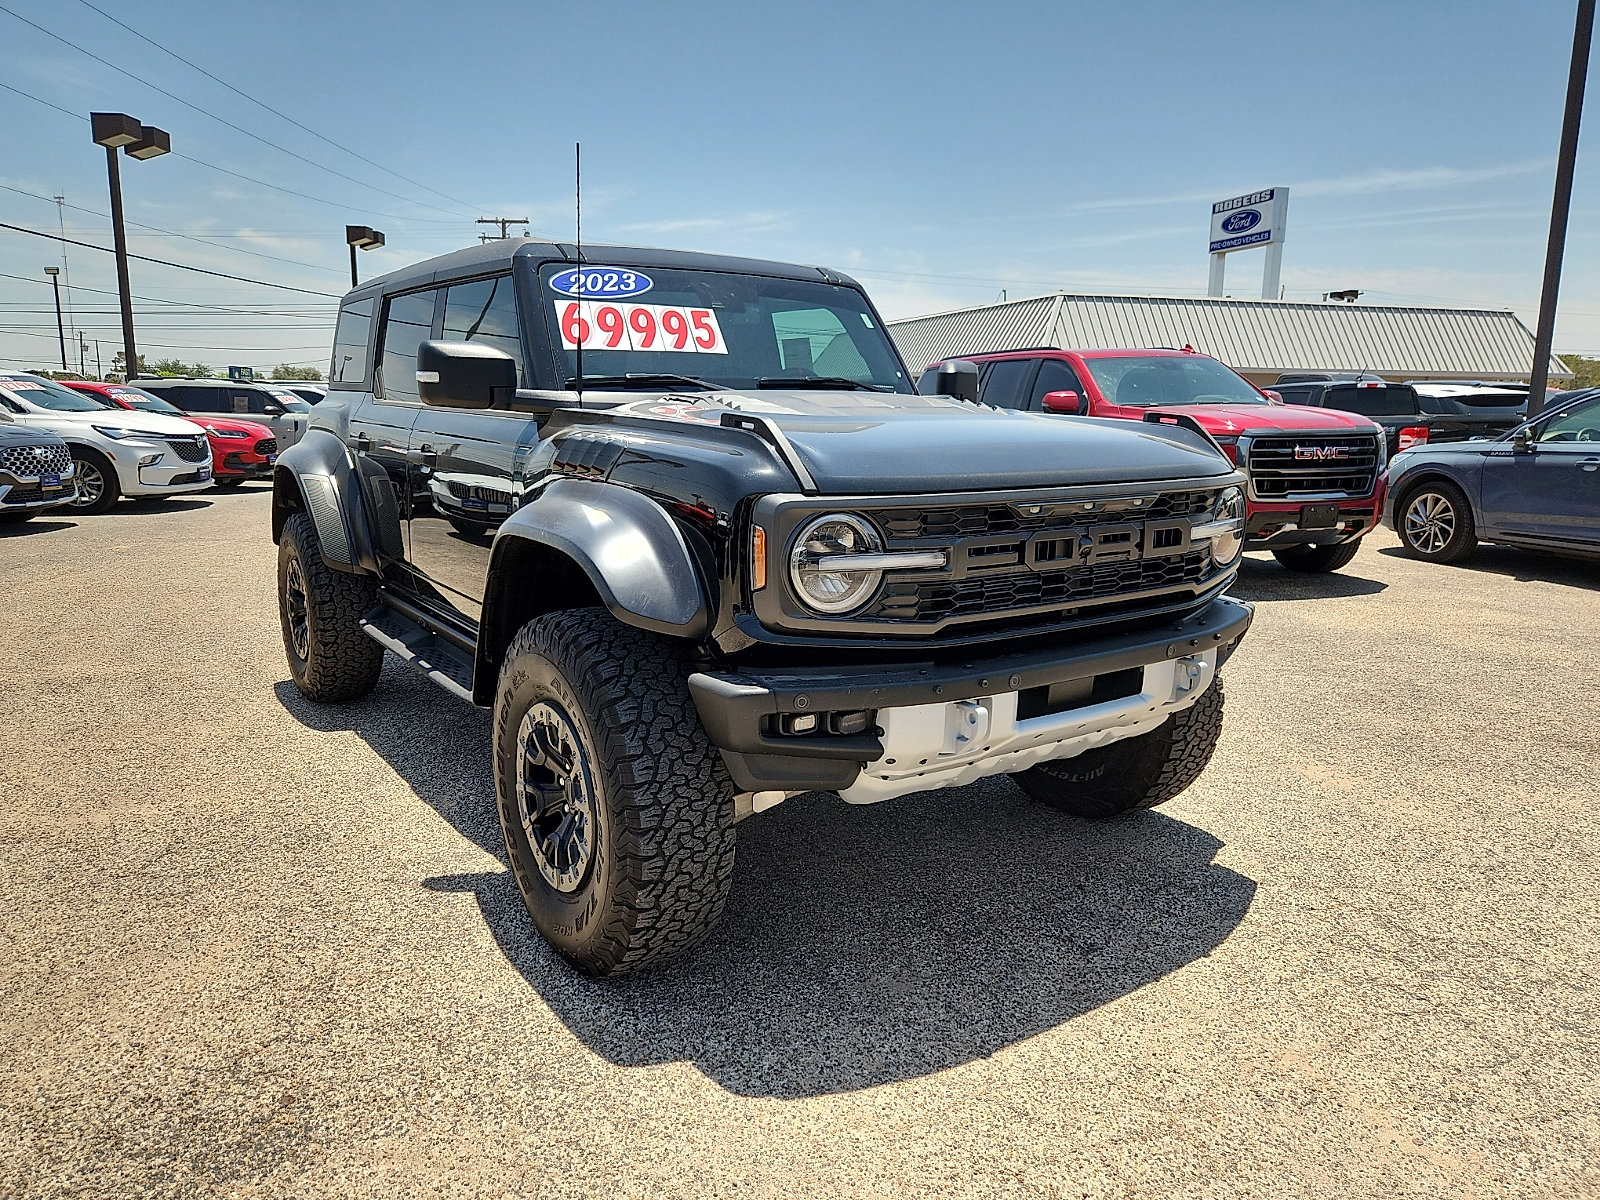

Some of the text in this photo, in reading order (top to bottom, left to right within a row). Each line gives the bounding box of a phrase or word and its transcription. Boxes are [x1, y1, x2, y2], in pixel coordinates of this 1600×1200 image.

[1214, 190, 1271, 213] ROGERS
[1228, 213, 1253, 230] Ford
[1210, 232, 1269, 250] PRE-OWNED VEHICLES
[568, 272, 636, 293] 2023
[561, 302, 717, 350] 69995
[1294, 446, 1349, 460] GMC
[950, 517, 1192, 580] FORD
